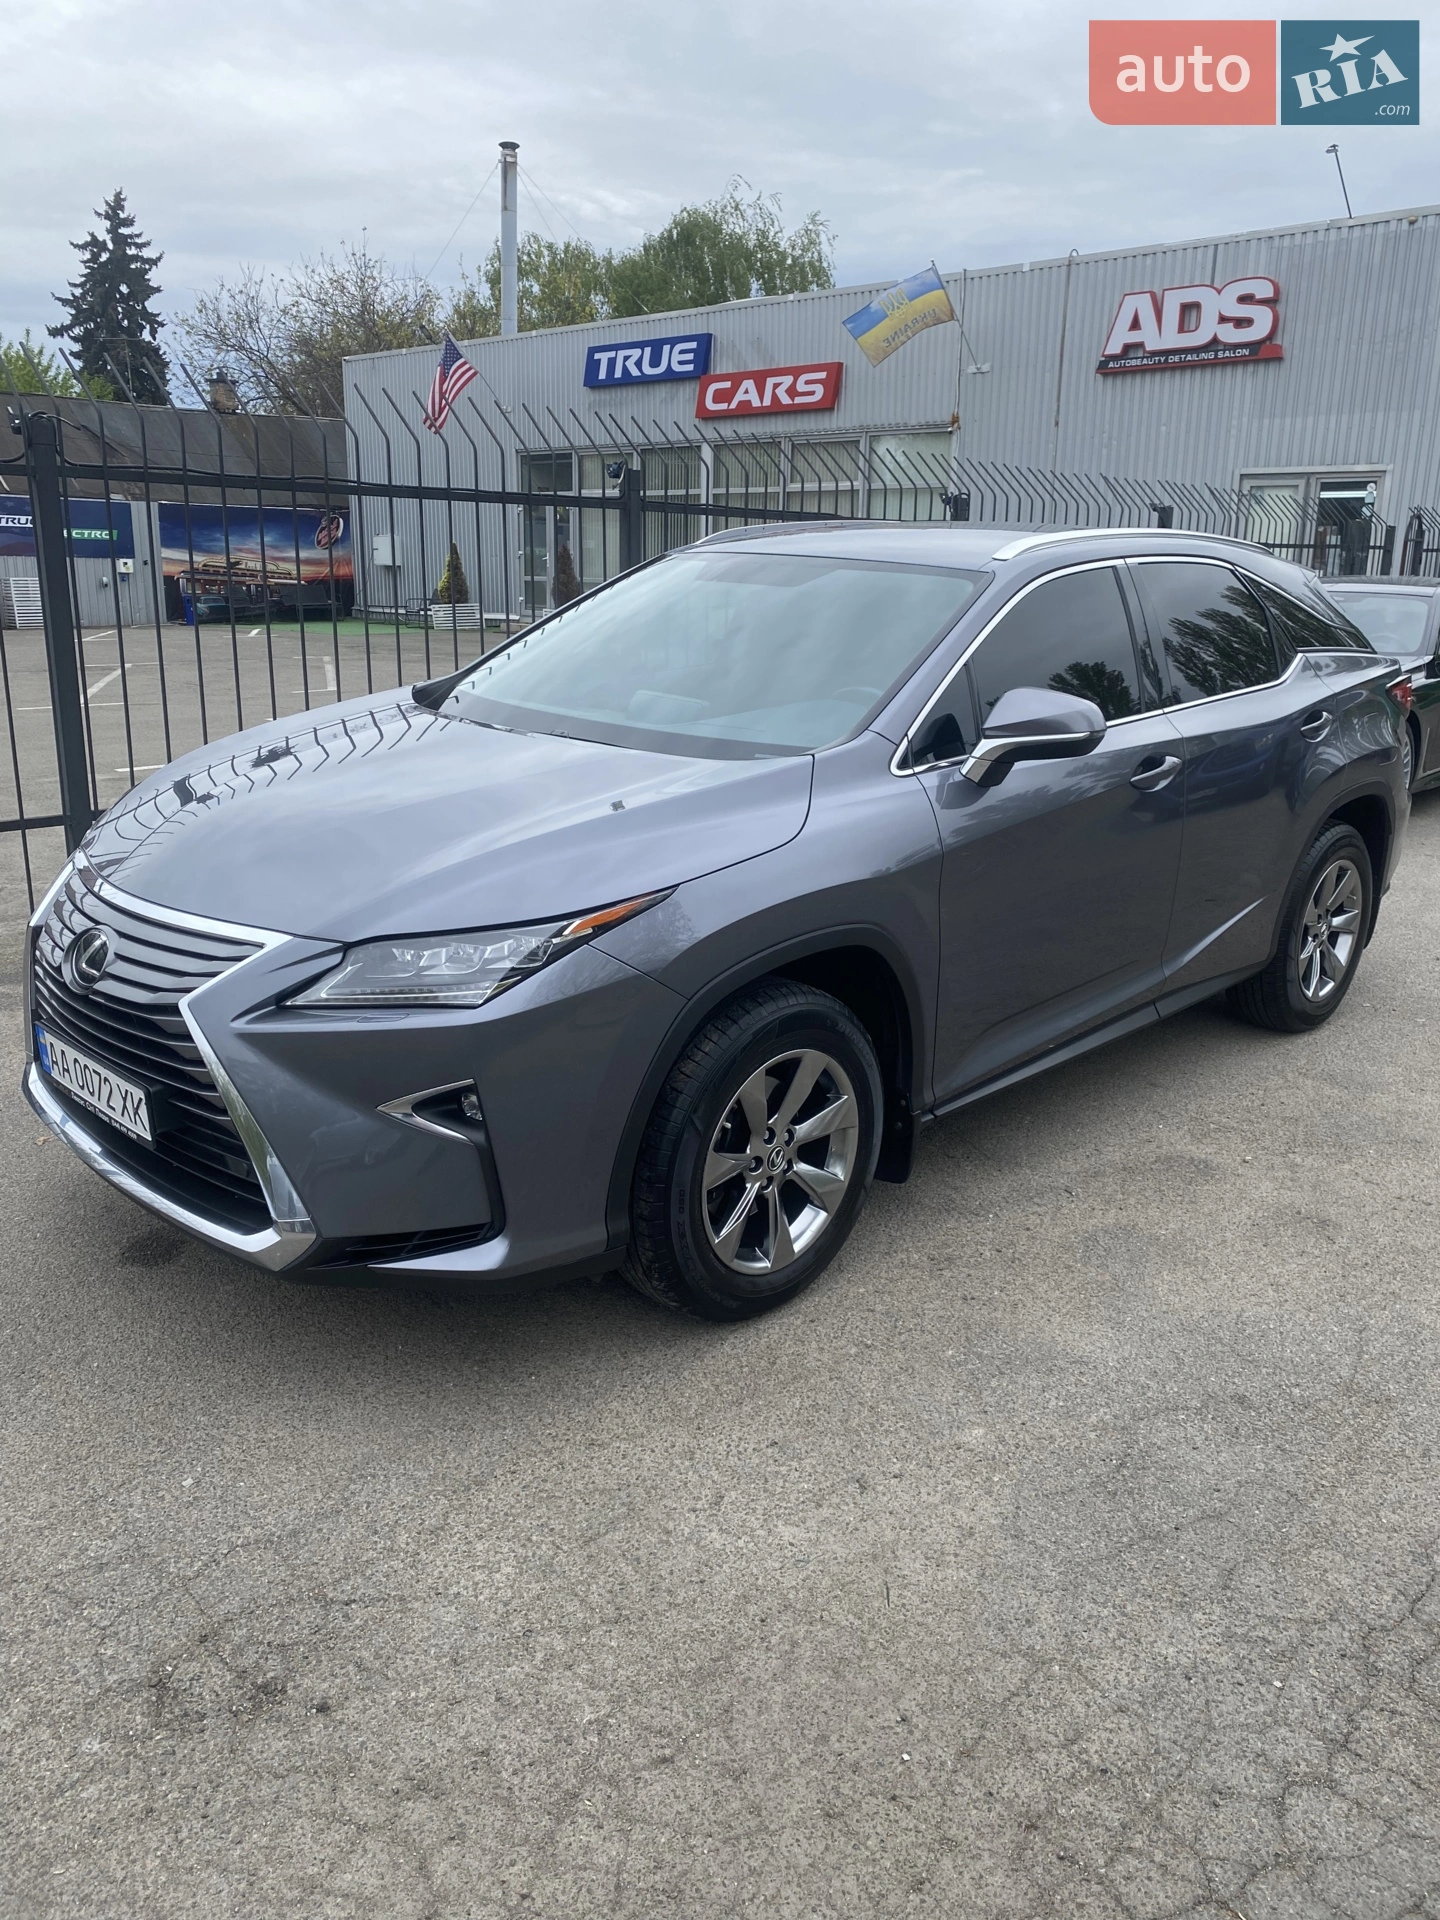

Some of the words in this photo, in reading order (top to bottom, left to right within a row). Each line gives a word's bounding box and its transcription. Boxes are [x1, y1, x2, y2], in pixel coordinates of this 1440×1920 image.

[1102, 276, 1279, 356] ADS
[594, 342, 697, 380] TRUE
[1108, 356, 1166, 368] AUTOBEAUTY
[1168, 351, 1215, 363] DETAILING
[1217, 348, 1250, 358] SALON
[705, 372, 827, 411] CARS
